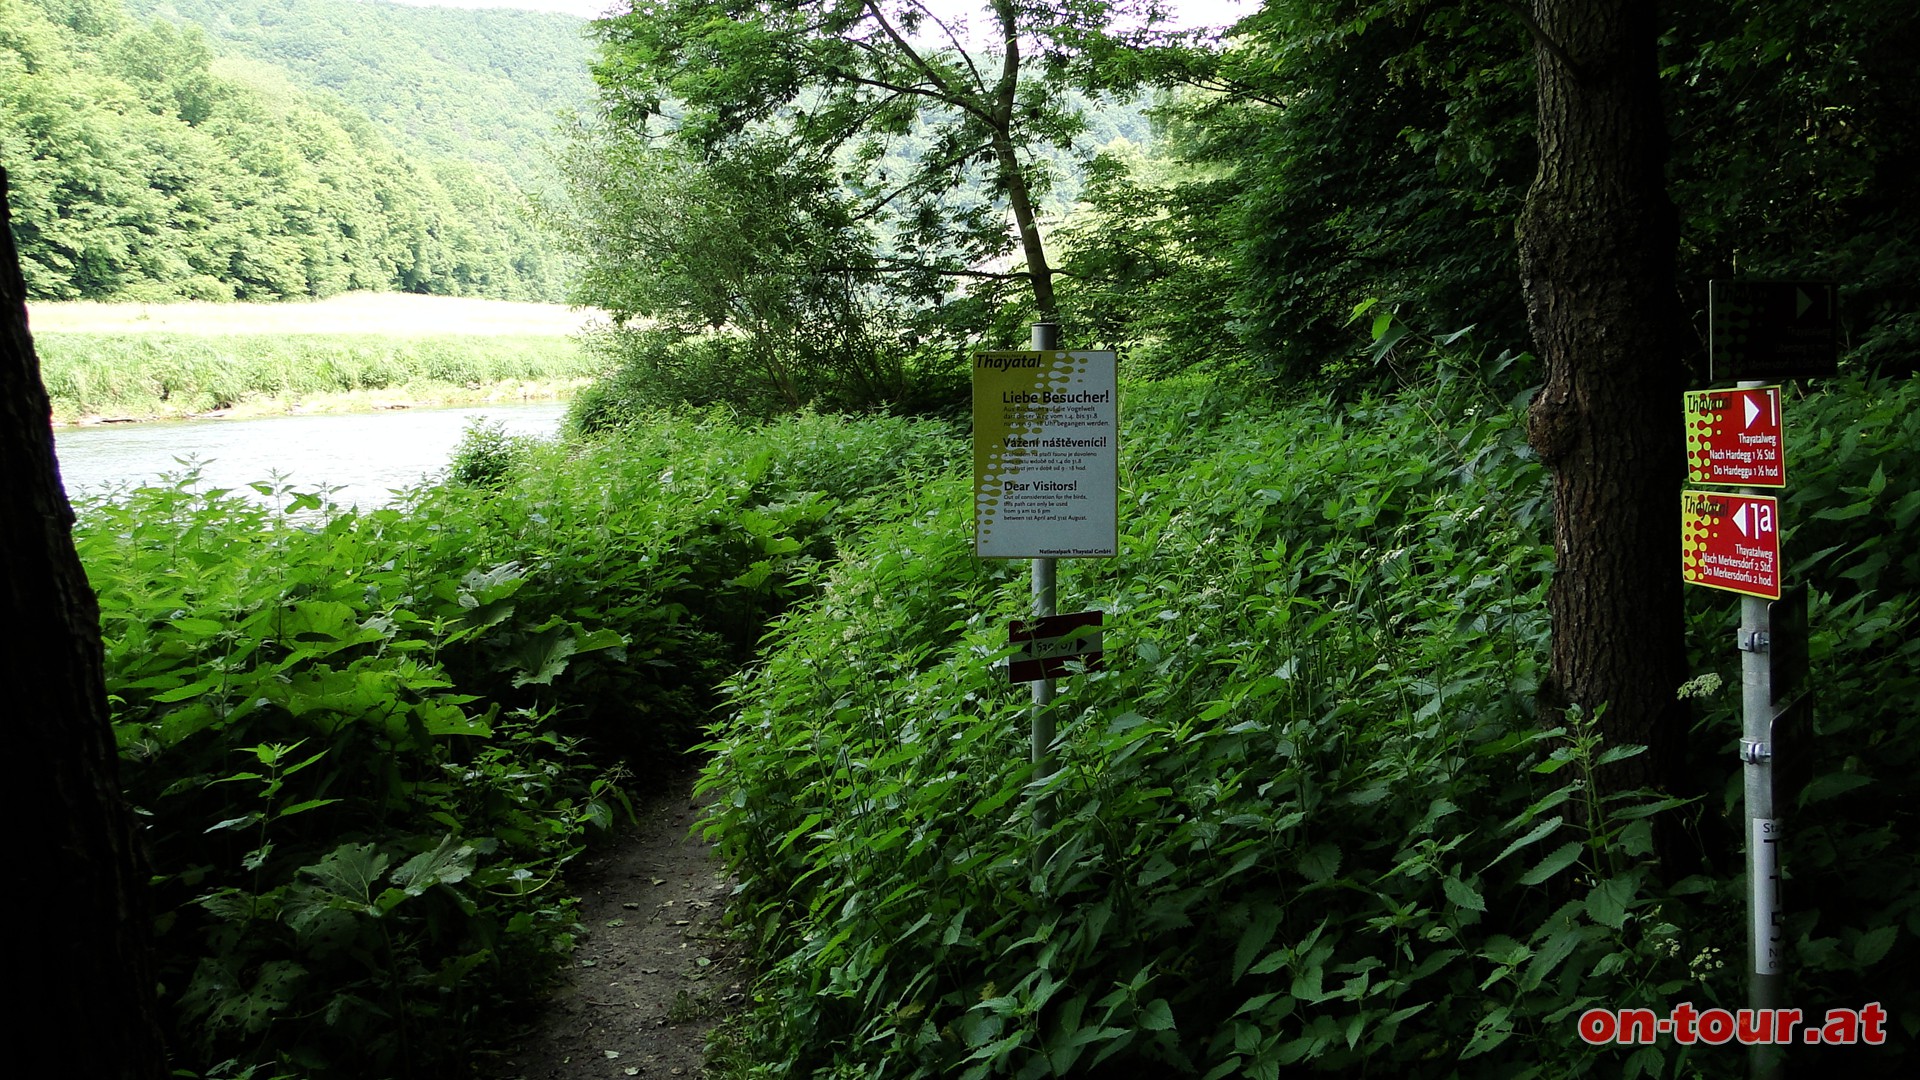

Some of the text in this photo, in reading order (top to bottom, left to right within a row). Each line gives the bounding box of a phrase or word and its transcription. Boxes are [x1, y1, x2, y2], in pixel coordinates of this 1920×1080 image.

[976, 354, 1042, 372] Thayatal
[1003, 390, 1109, 403] Liebe Besucher!
[1066, 406, 1095, 415] Vogelwelt
[1766, 389, 1776, 426] 1
[1045, 420, 1056, 428] Uhr
[1056, 420, 1085, 428] begangen
[1050, 413, 1063, 421] vom
[1076, 413, 1085, 421] bis
[1003, 438, 1039, 448] Vážení
[1738, 432, 1776, 447] Thayatalweg
[1709, 450, 1724, 460] Nach
[1726, 449, 1751, 463] Hardegg
[1713, 465, 1722, 475] Do
[1723, 465, 1752, 479] Hardeggu
[1004, 480, 1077, 491] Dear Visitors!
[1750, 503, 1772, 540] 1a
[1735, 543, 1773, 562] Thayatalweg
[1702, 552, 1773, 572] Nach Merkersdorf 2 Std.
[1703, 565, 1712, 576] Do
[1713, 566, 1752, 583] Merkersdorfu
[1759, 573, 1773, 586] hod.
